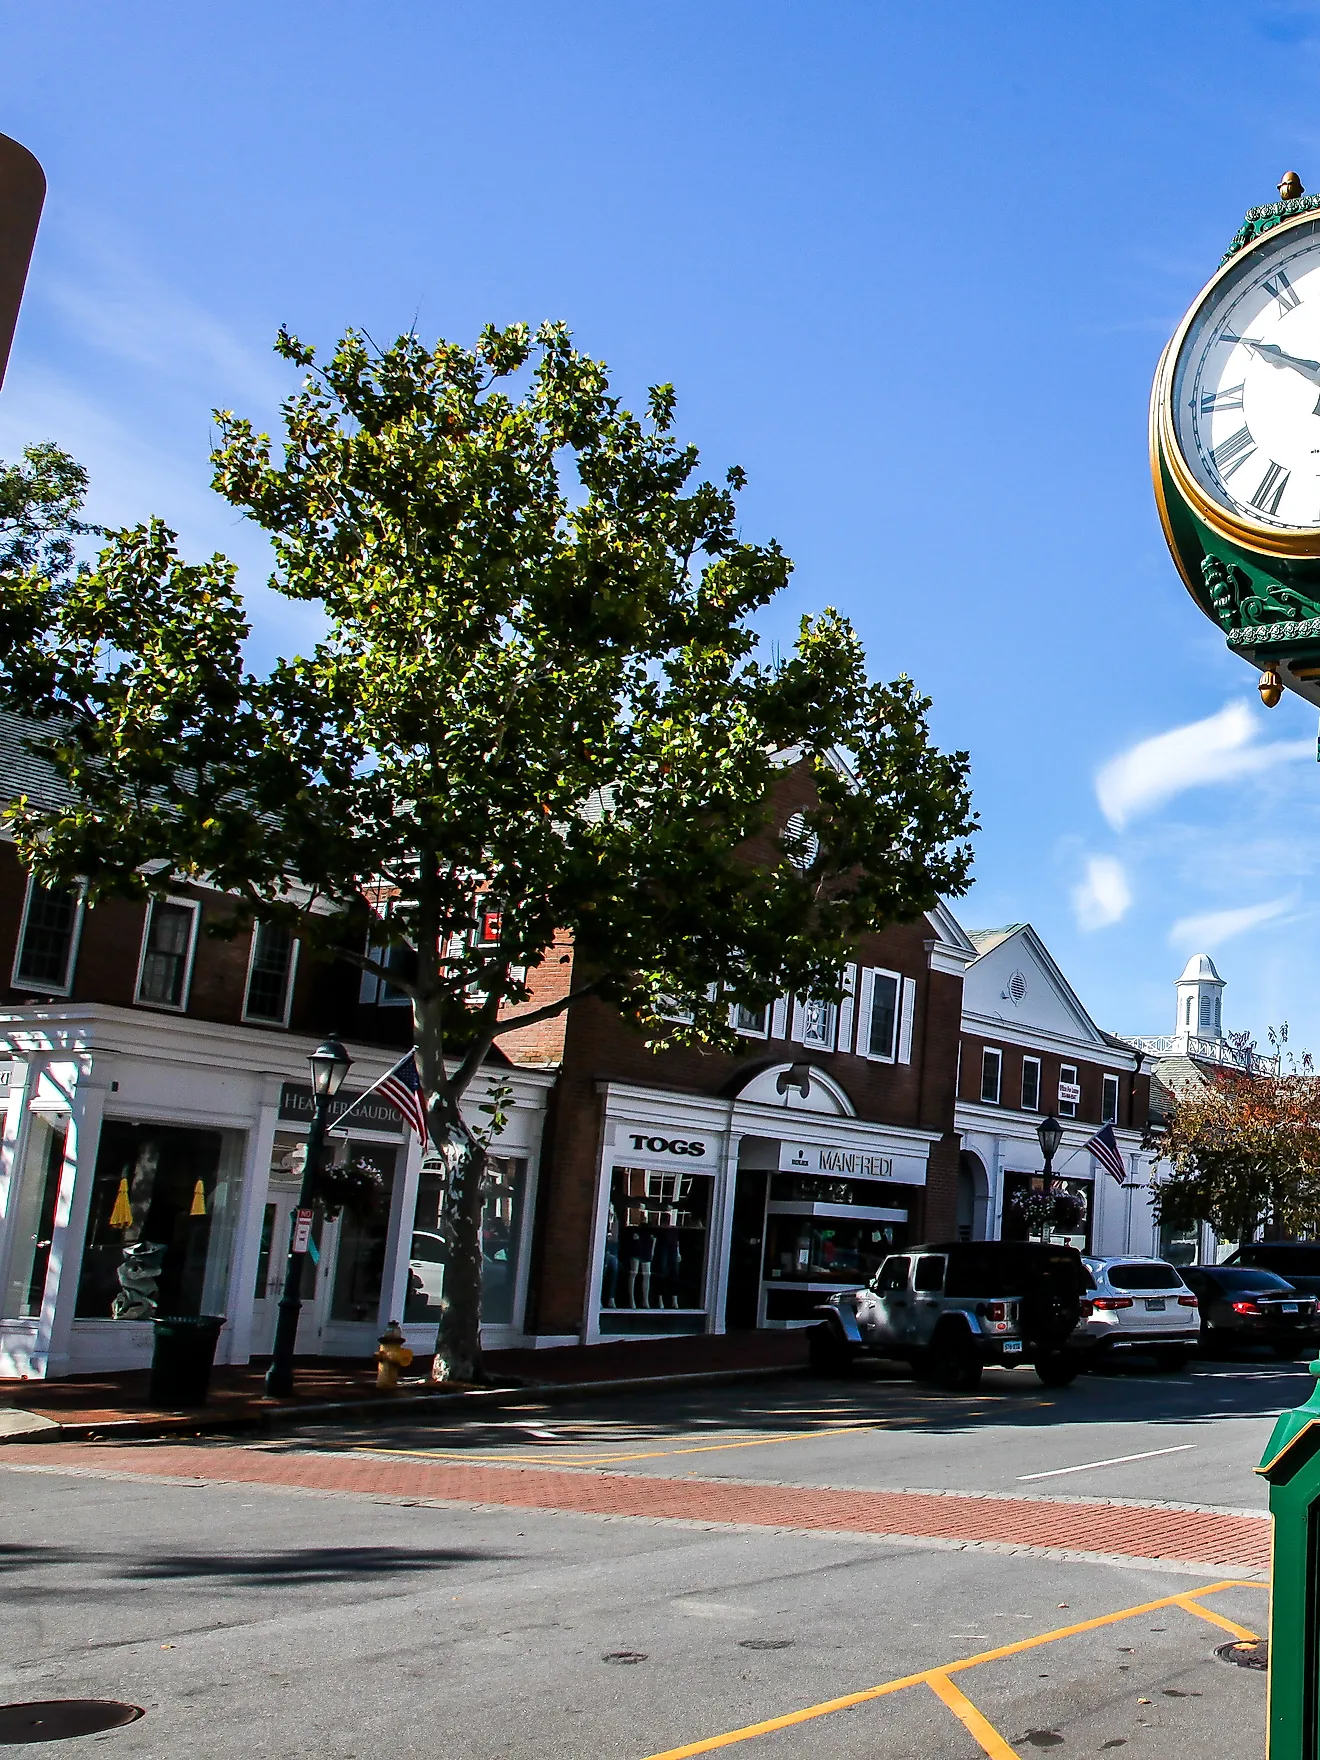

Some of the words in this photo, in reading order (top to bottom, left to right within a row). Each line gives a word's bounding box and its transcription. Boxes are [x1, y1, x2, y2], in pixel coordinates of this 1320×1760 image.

[1258, 267, 1304, 320] XI
[1201, 378, 1246, 419] IX
[1246, 459, 1291, 517] VII
[285, 1093, 347, 1114] HEAER
[629, 1134, 706, 1157] TOGS
[819, 1150, 893, 1177] MANFREDI
